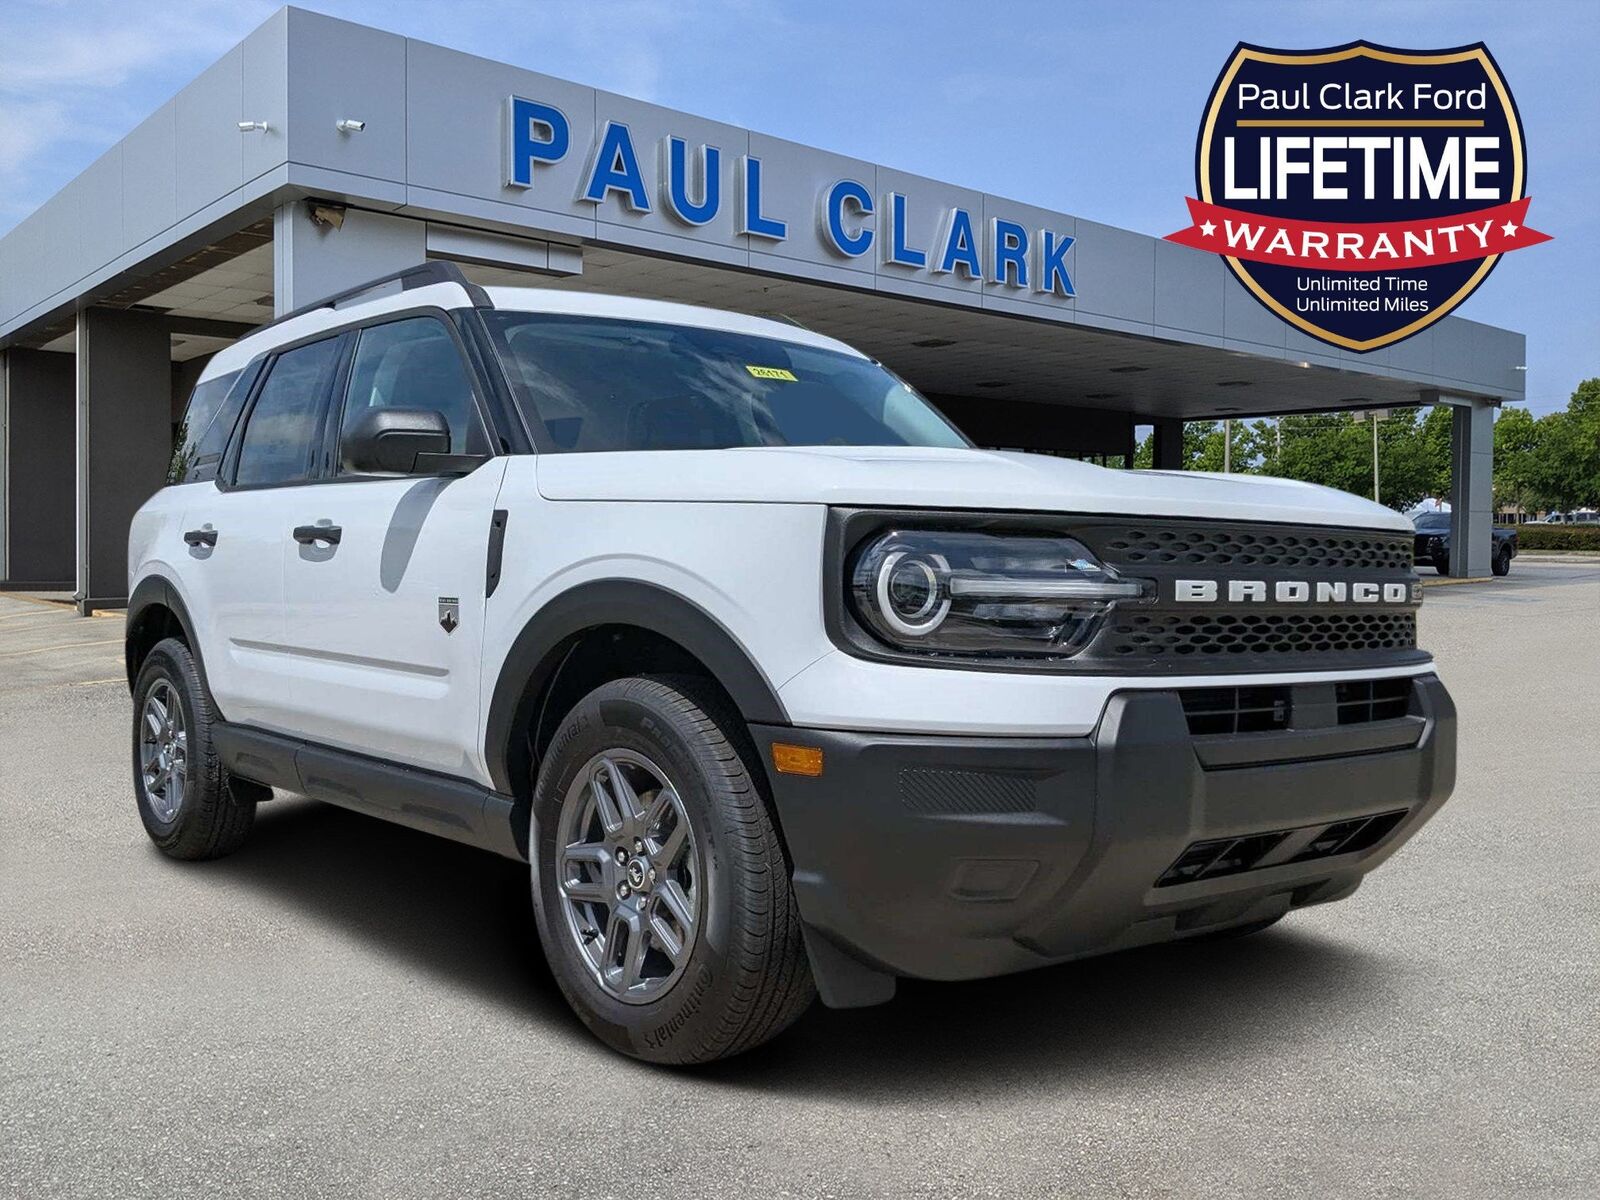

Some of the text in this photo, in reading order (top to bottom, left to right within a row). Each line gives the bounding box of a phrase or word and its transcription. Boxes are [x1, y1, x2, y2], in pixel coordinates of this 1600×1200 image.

[508, 94, 1077, 298] PAUL CLARK
[1175, 580, 1407, 602] BRONCO
